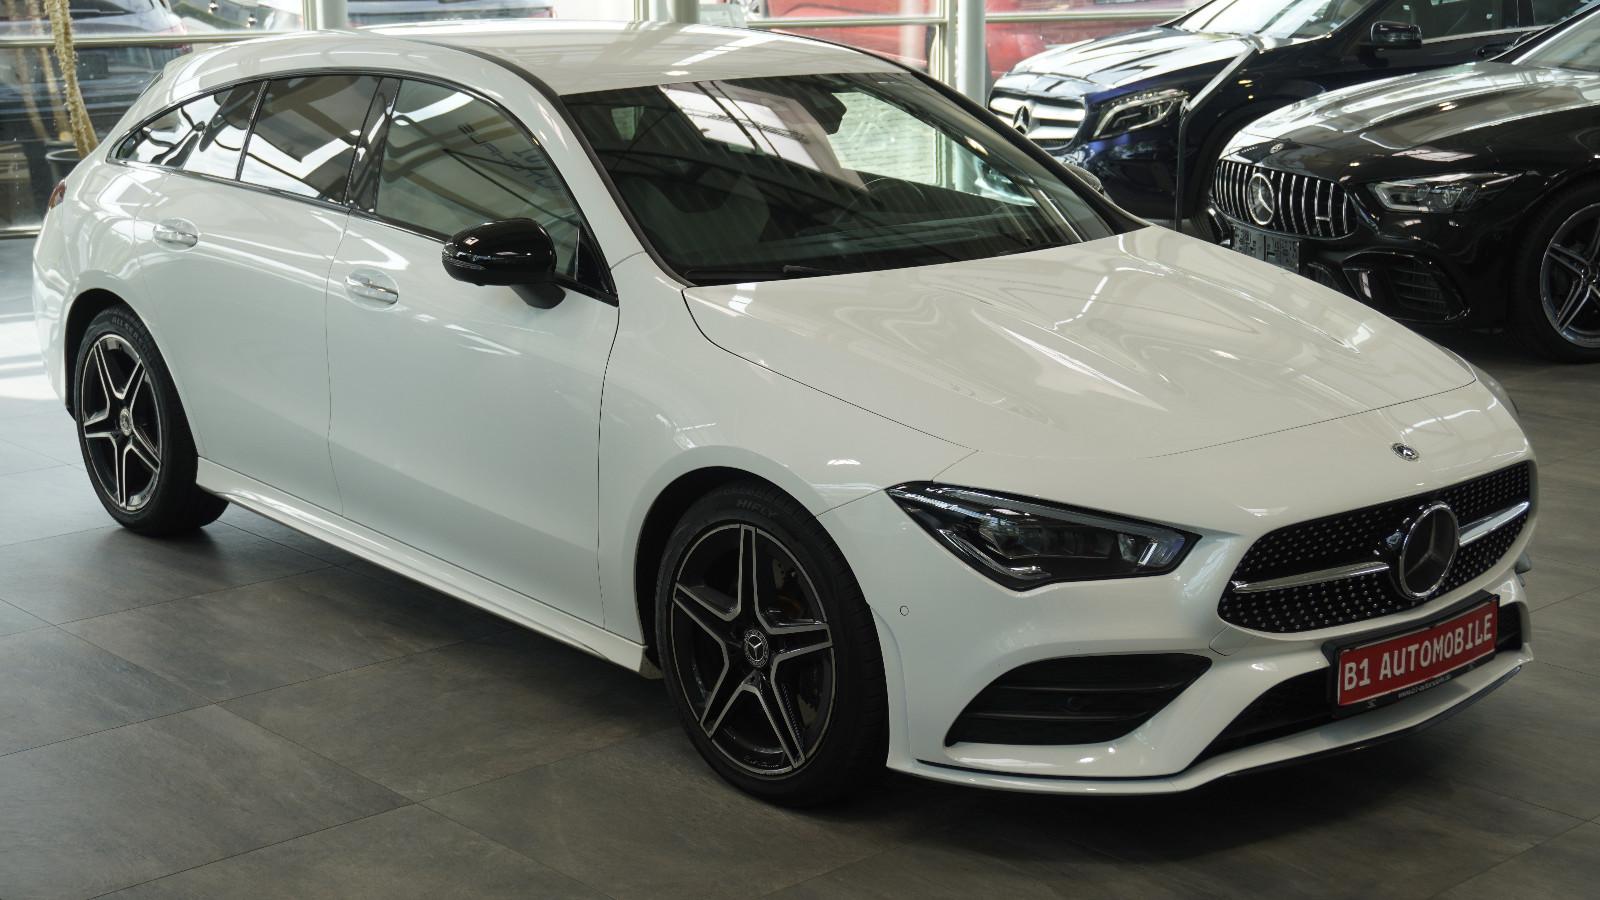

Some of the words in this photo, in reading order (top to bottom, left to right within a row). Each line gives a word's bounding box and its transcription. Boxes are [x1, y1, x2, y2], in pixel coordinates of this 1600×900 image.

[736, 499, 777, 518] HIFLY
[1344, 658, 1370, 690] B1
[1379, 614, 1492, 680] AUTOMOBILE
